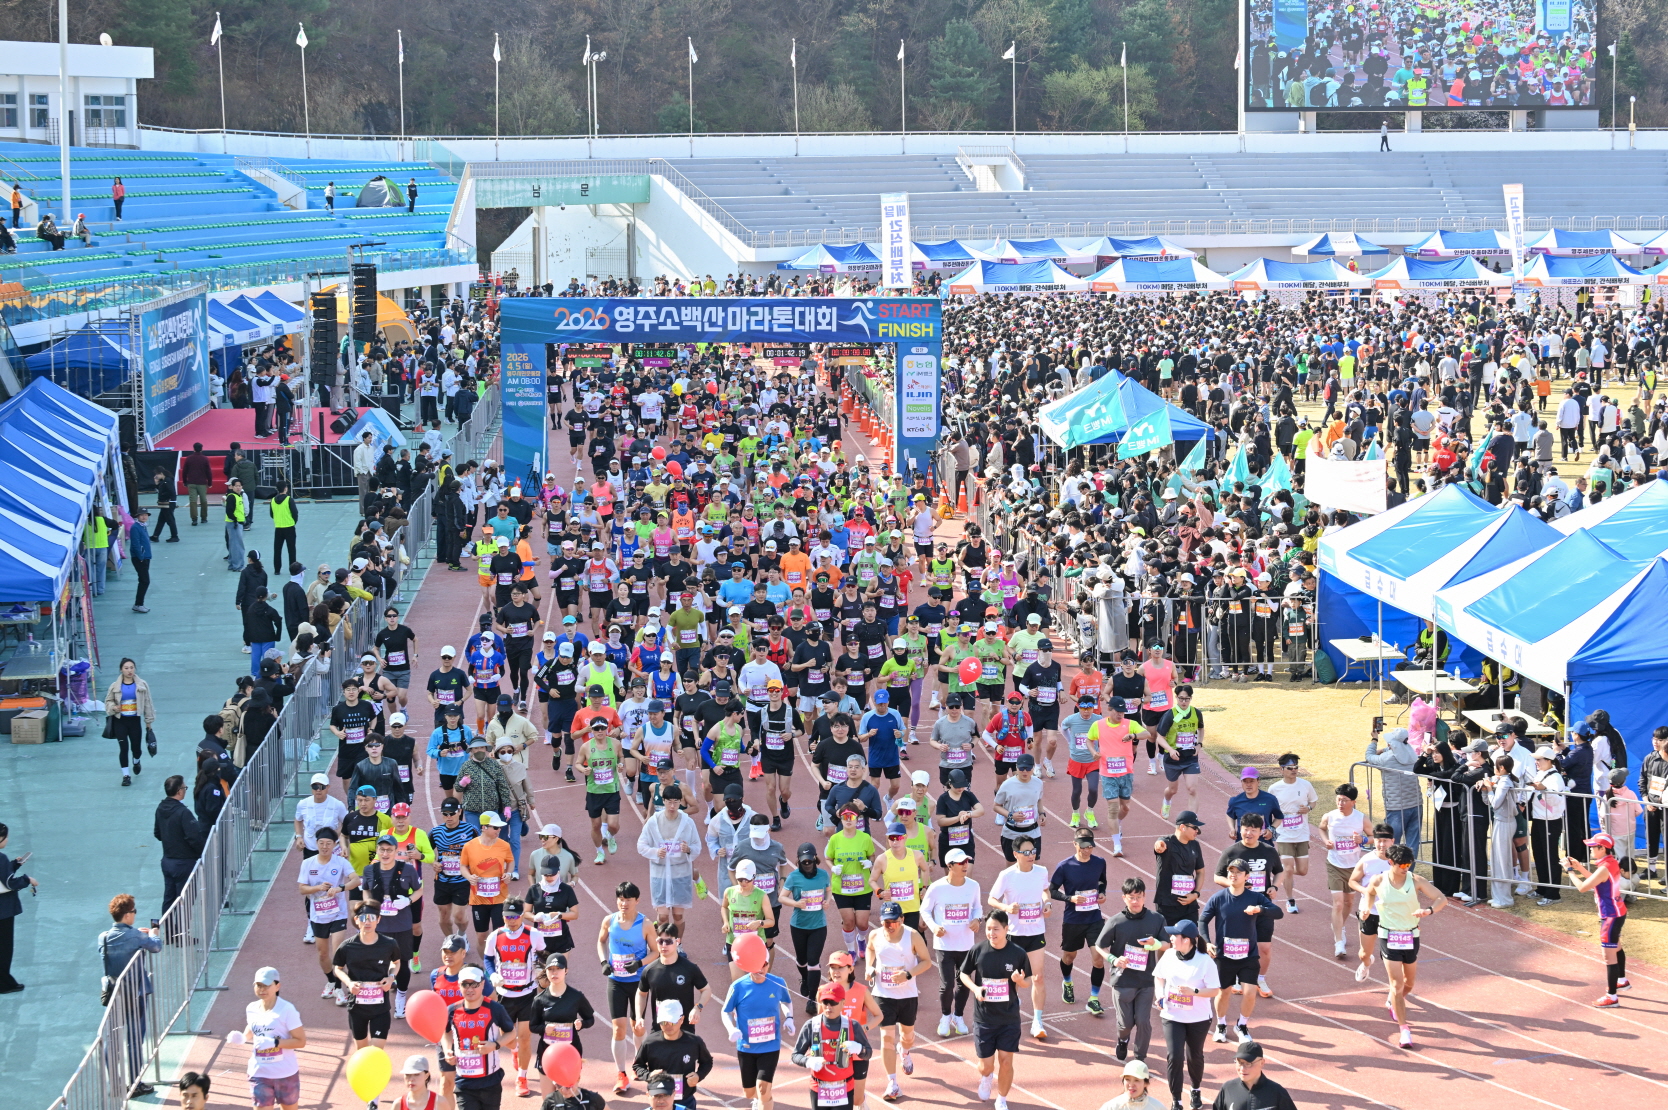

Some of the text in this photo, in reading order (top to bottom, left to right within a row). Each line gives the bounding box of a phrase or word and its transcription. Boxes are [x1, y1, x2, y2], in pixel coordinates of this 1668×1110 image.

[878, 304, 933, 318] START
[554, 306, 837, 332] 2026 영주소백산마라톤대회
[878, 323, 933, 337] FINISH
[507, 353, 528, 361] 2026
[316, 901, 336, 909] 21052
[1126, 952, 1146, 962] 20896
[750, 1025, 774, 1034] 20964
